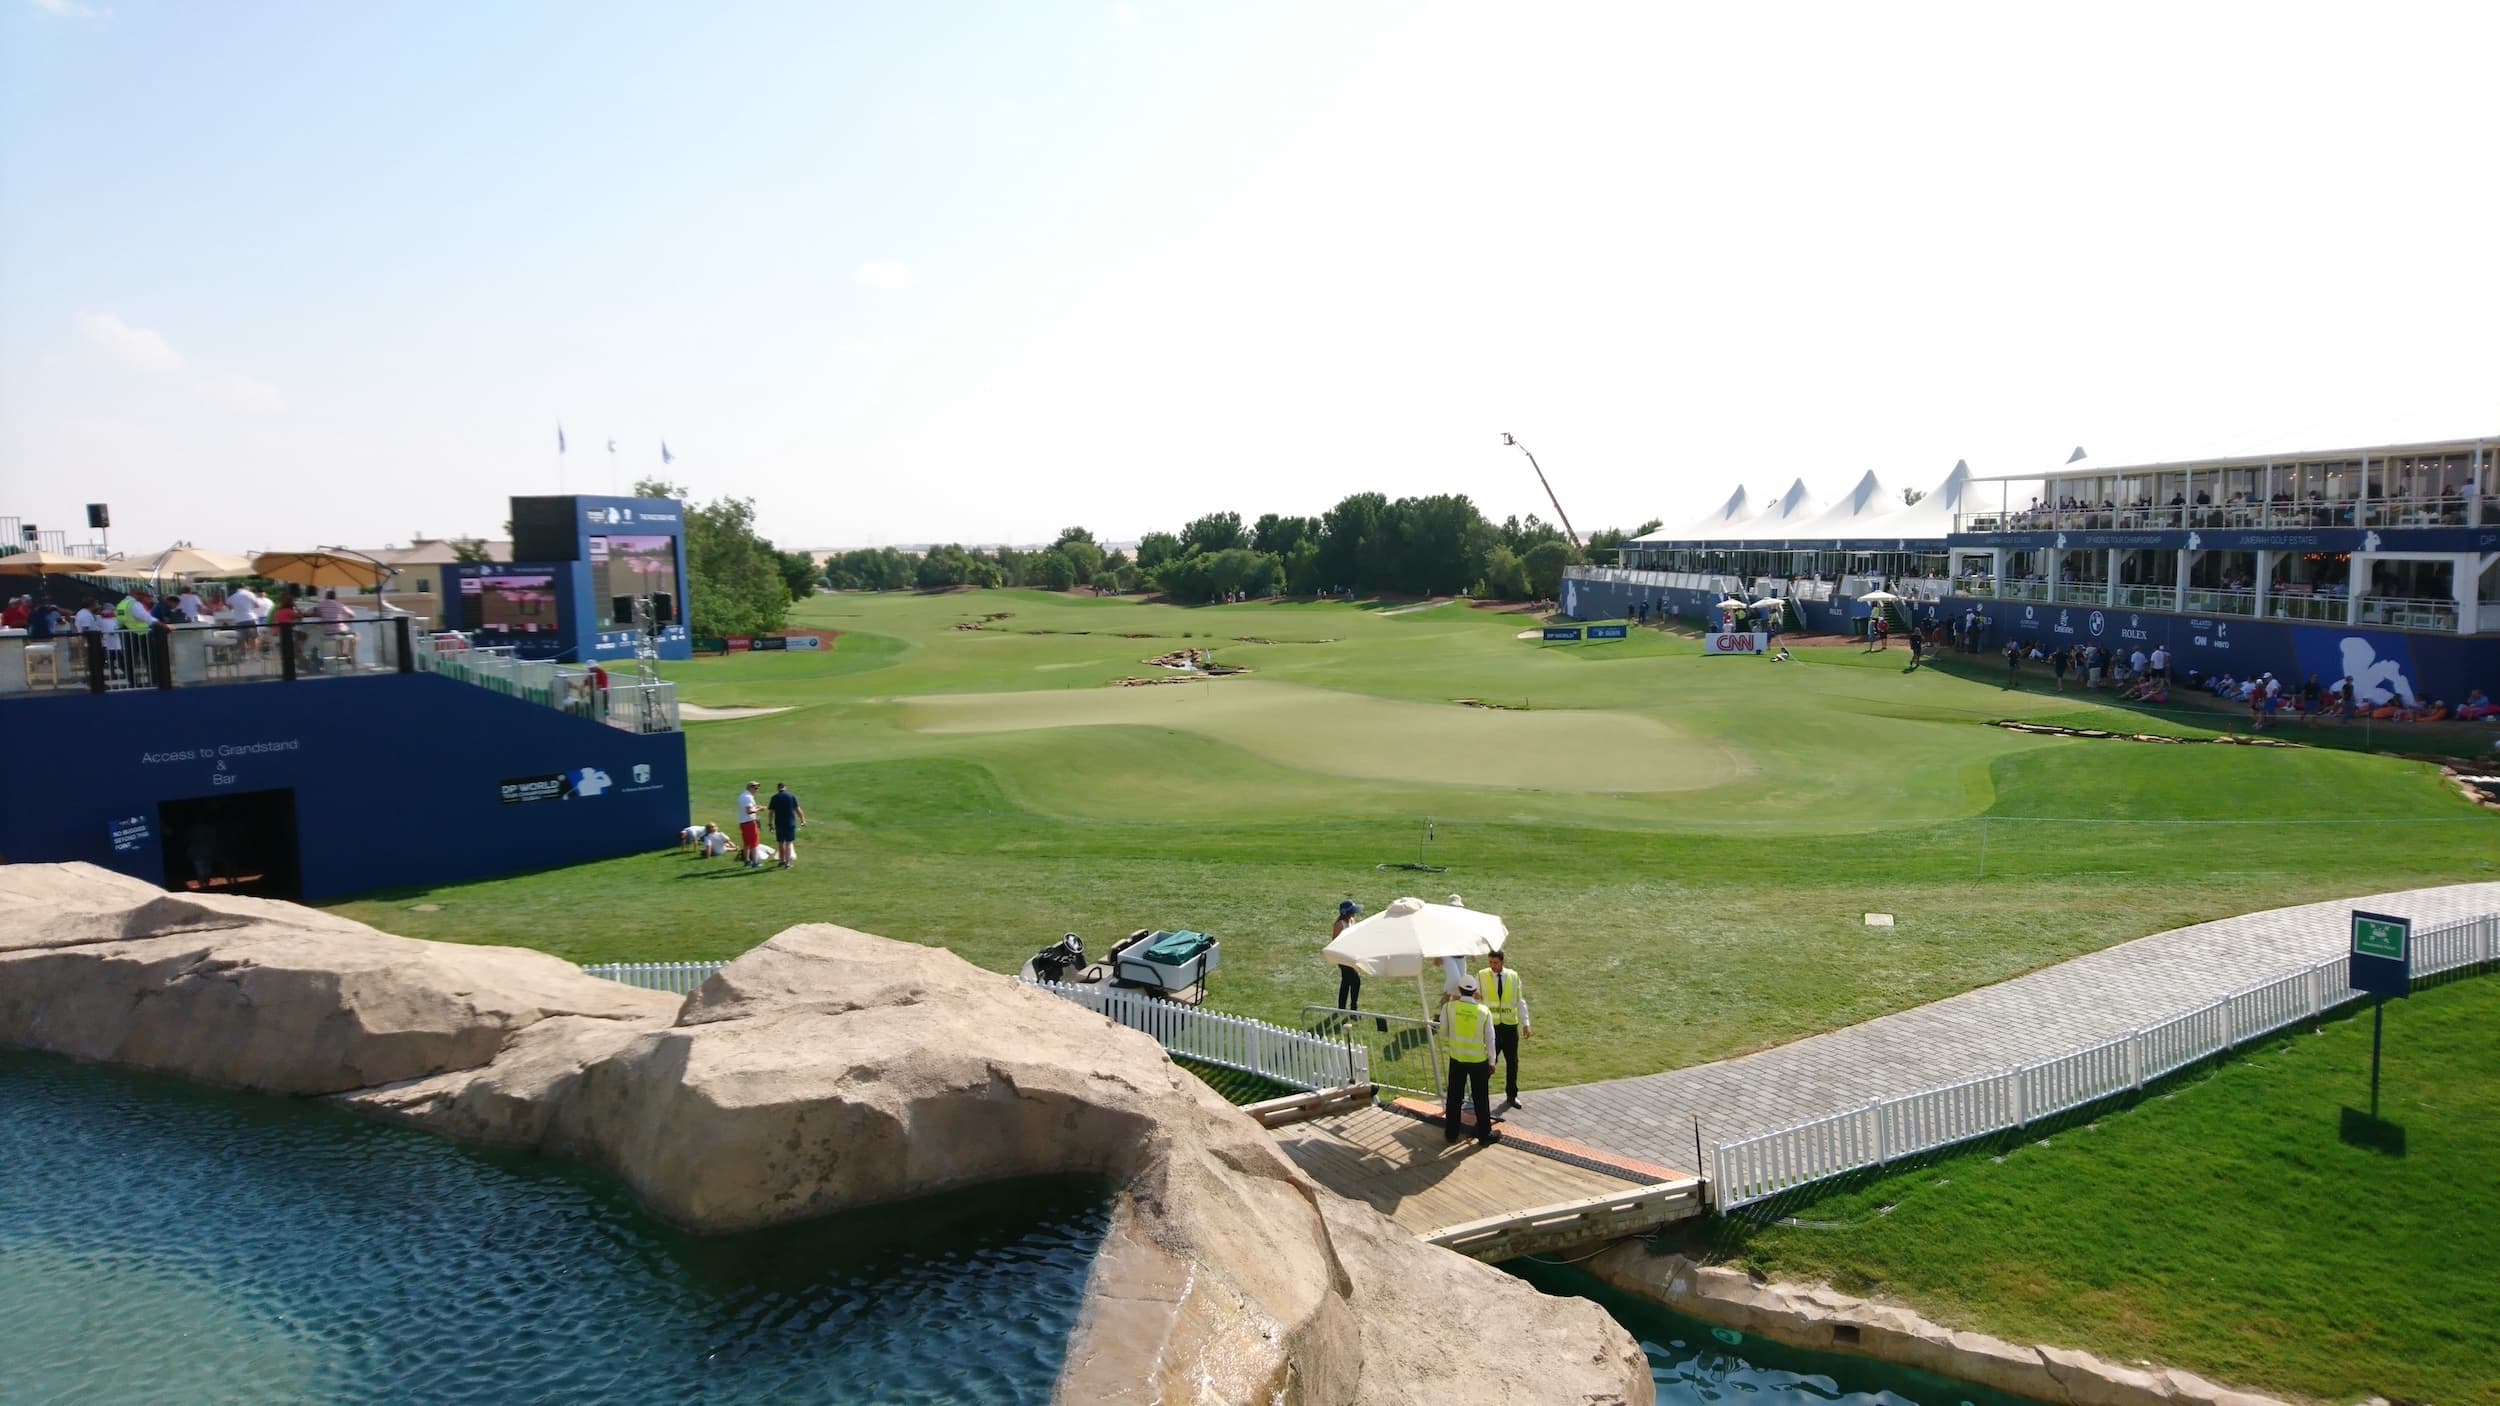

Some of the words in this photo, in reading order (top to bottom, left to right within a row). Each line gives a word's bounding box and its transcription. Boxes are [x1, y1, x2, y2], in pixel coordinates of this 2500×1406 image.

[2271, 535, 2287, 545] GOLF
[2288, 535, 2318, 545] ESTATES
[2480, 535, 2497, 545] DP
[2054, 624, 2074, 634] Emirates
[2121, 628, 2148, 640] ROLEX
[1716, 634, 1754, 651] CNN
[2194, 635, 2208, 646] CNN
[142, 751, 196, 764] Access
[200, 748, 215, 758] to
[218, 739, 298, 757] Grandstand
[216, 759, 227, 771] &
[213, 773, 237, 785] Bar
[502, 785, 517, 793] DP
[518, 780, 560, 791] WORLD
